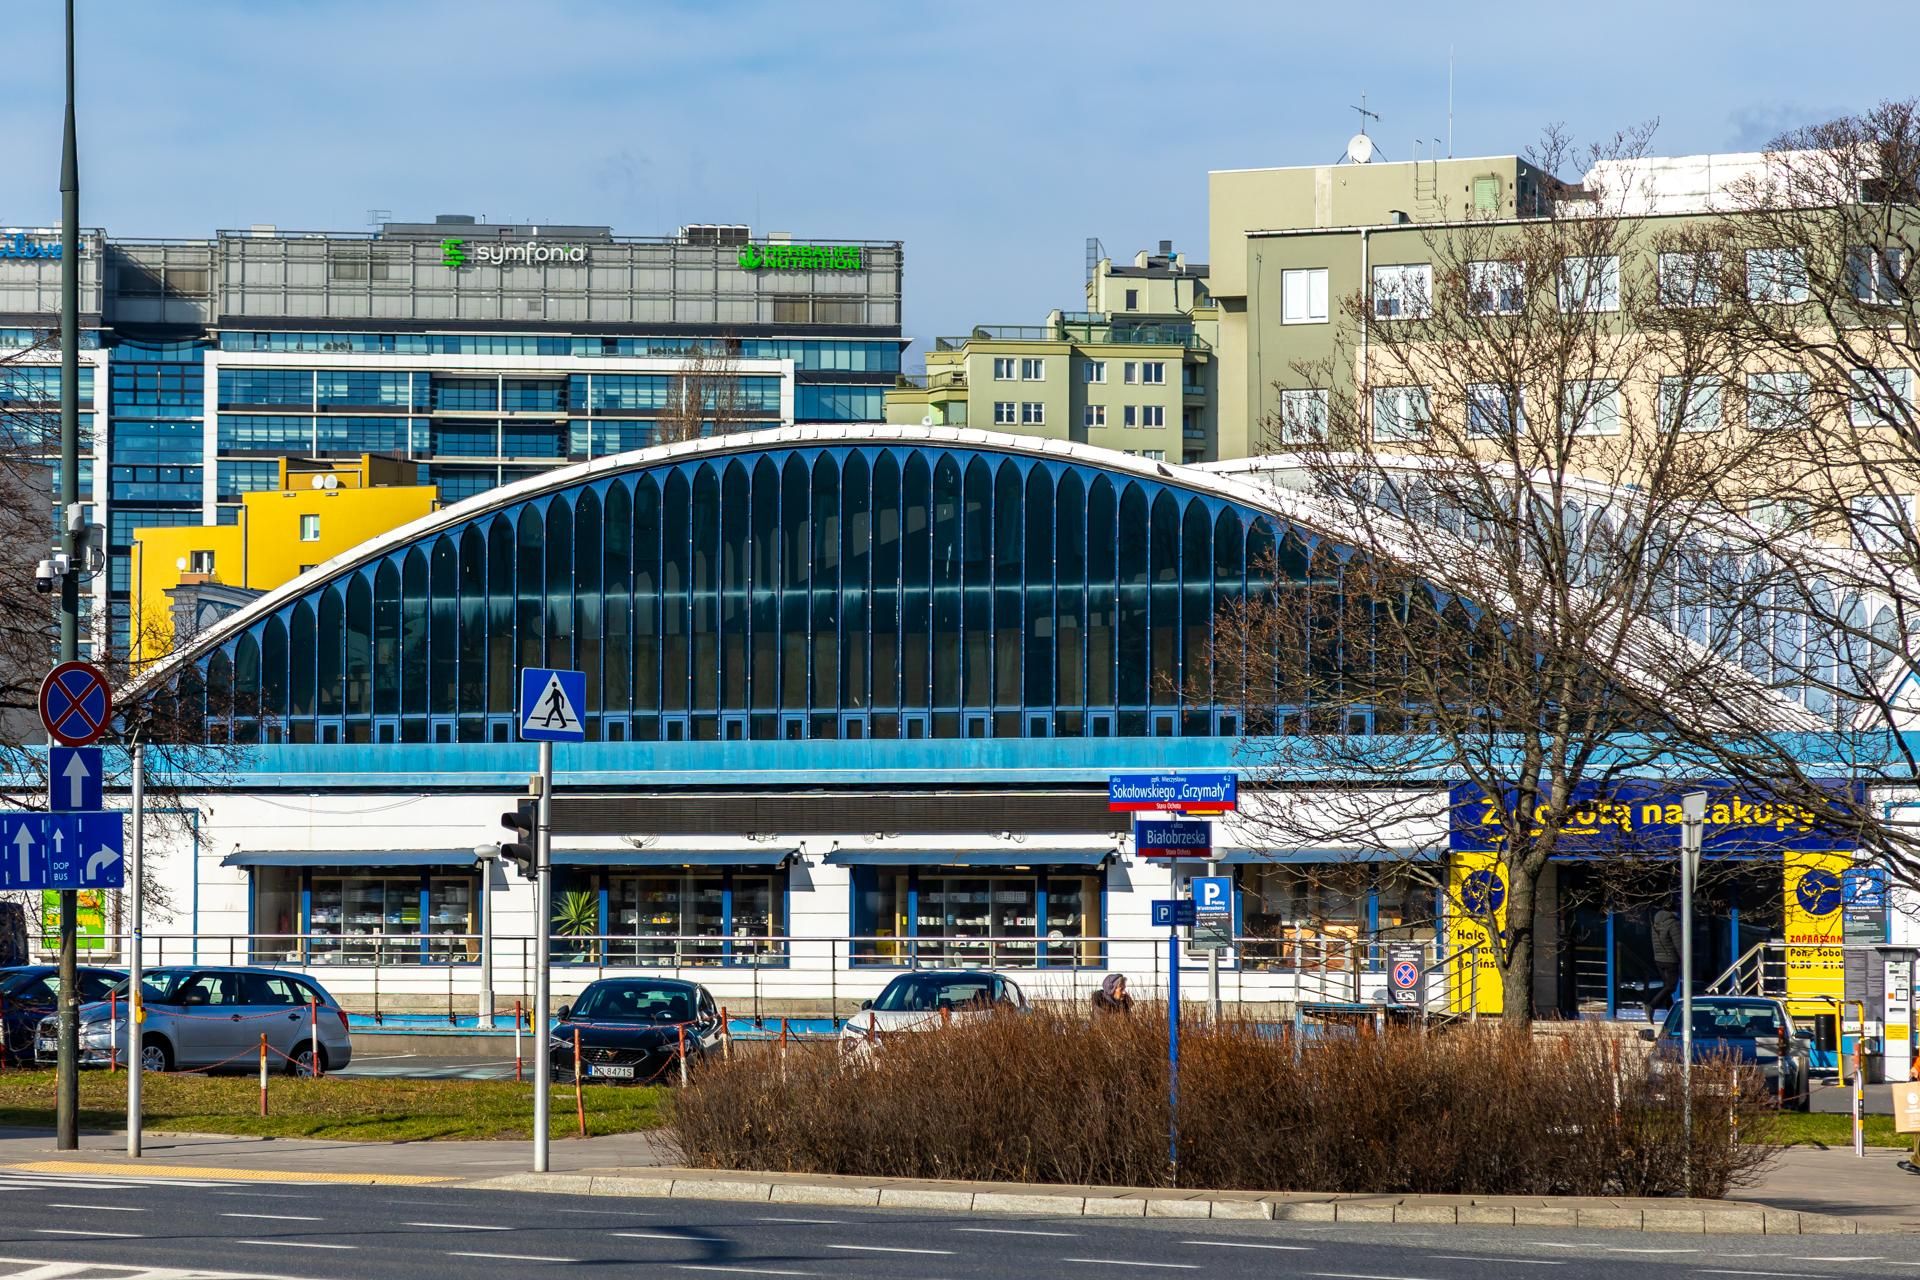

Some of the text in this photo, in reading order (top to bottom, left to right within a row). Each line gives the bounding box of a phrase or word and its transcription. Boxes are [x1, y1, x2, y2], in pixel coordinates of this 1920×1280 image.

[477, 242, 584, 265] symfonia
[764, 245, 861, 257] HERBALIFE
[764, 257, 860, 269] NUTRITION
[1112, 784, 1176, 802] Sokołowskiego
[1642, 804, 1683, 825] na
[1147, 829, 1206, 844] Białobrzeska
[54, 862, 69, 870] DOP
[1204, 882, 1220, 906] P
[607, 1067, 632, 1076] 8471S
